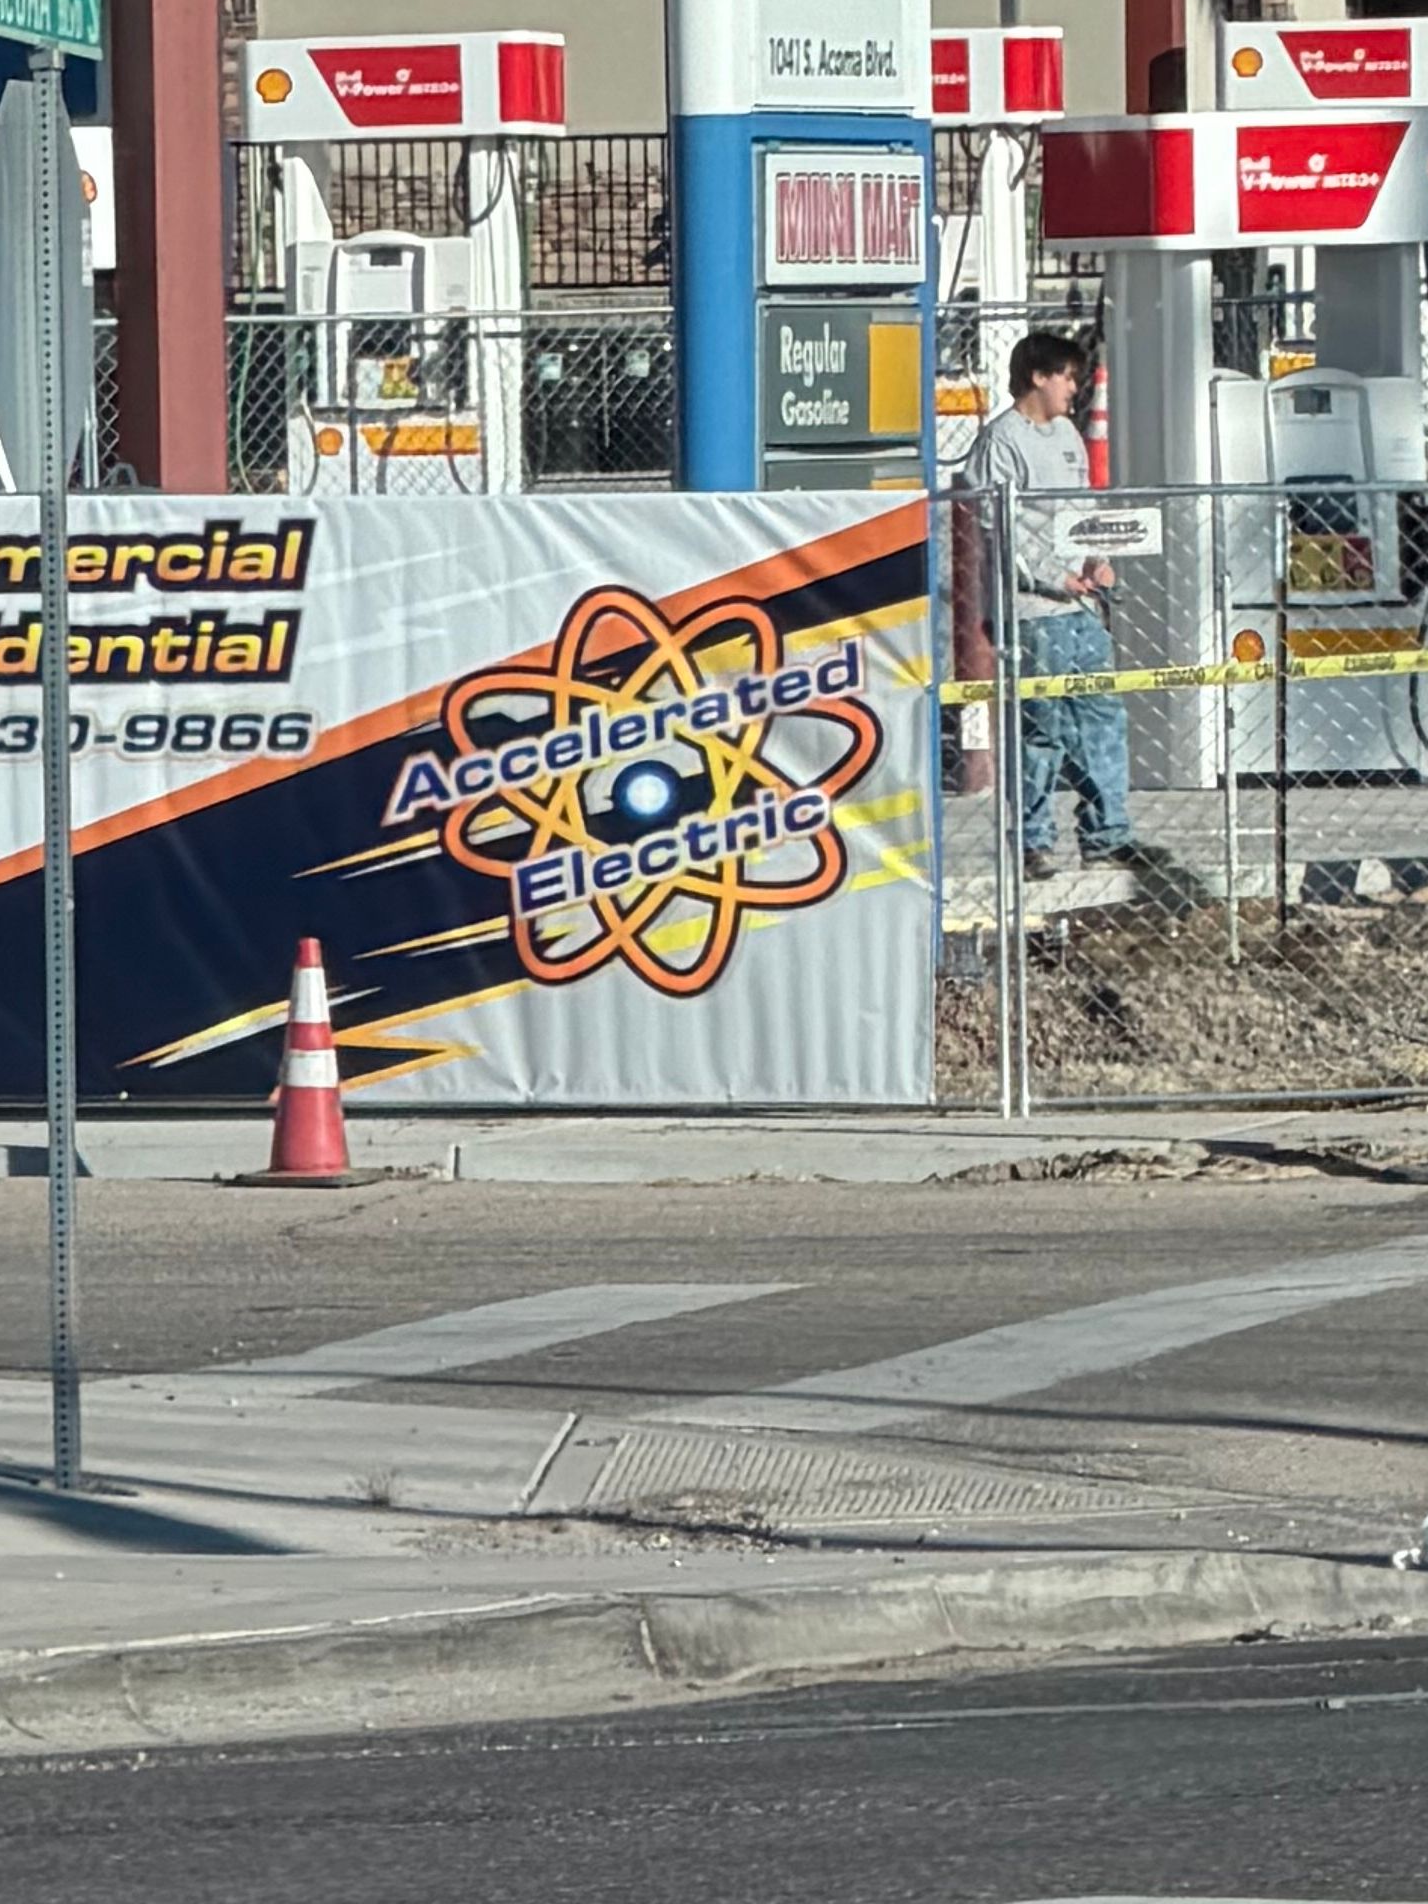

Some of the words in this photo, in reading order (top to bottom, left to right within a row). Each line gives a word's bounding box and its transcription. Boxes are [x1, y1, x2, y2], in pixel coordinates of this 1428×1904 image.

[779, 321, 847, 387] Regular
[781, 389, 850, 426] Gasoline
[388, 640, 862, 820] Accelerated
[515, 792, 829, 914] Electric
